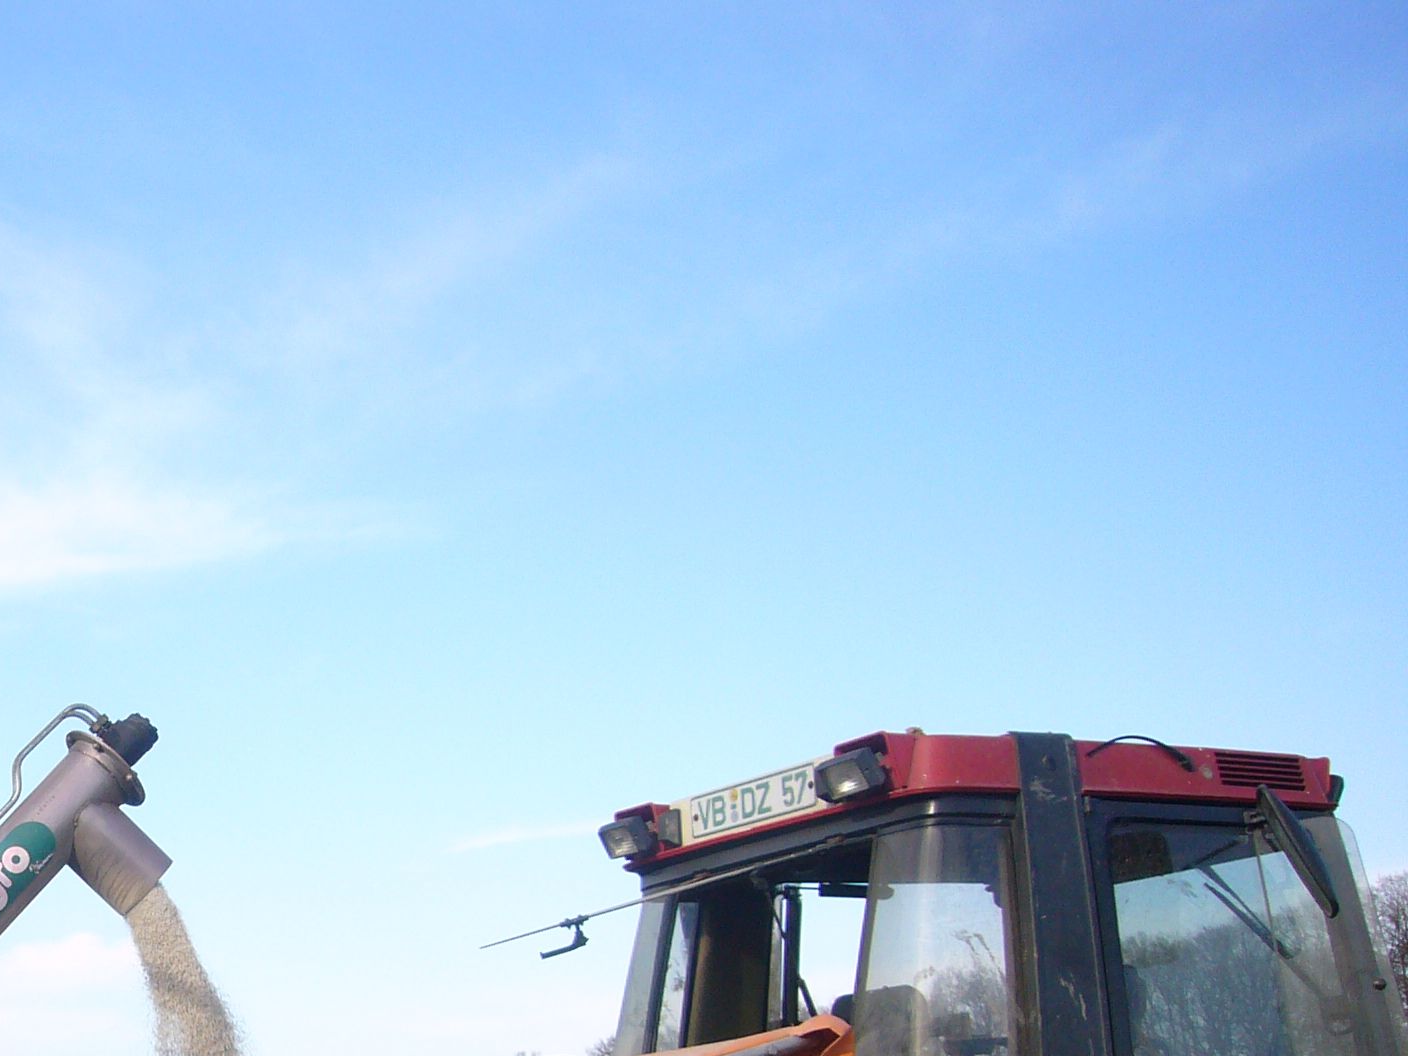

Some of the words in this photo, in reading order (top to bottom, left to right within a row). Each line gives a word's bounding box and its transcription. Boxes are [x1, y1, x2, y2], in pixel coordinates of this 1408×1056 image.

[698, 796, 726, 830] VB
[740, 781, 772, 819] DZ
[782, 770, 808, 807] 57
